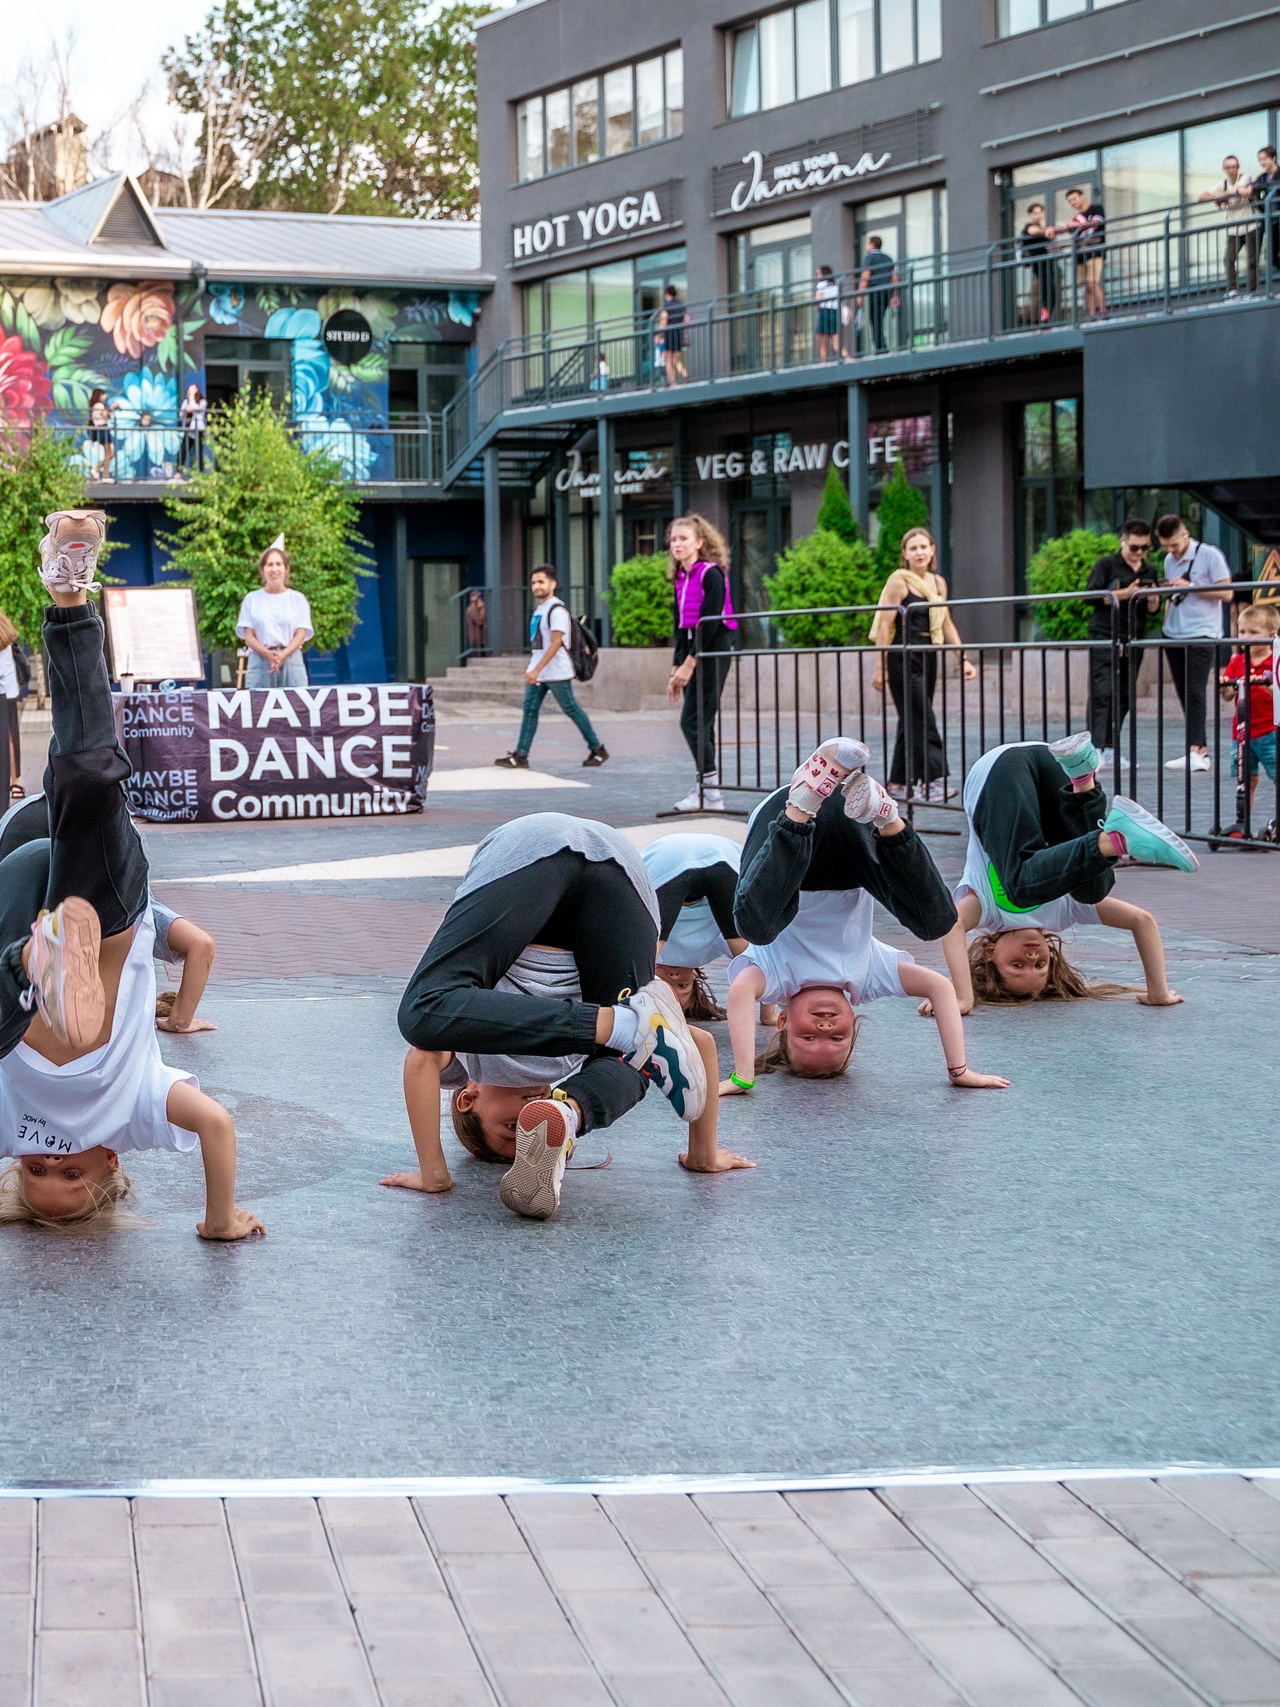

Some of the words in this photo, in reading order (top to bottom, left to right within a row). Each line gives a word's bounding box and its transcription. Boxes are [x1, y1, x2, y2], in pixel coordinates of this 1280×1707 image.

[773, 161, 802, 180] HOT
[802, 151, 839, 172] YOGA
[514, 215, 570, 258] HOT
[577, 191, 662, 240] YOGA
[695, 452, 745, 480] VEG
[750, 449, 767, 476] &
[773, 441, 829, 474] RAW
[832, 435, 901, 468] CFE
[122, 706, 195, 724] DANCE
[207, 686, 413, 729] MAYBE
[123, 724, 195, 738] Community
[209, 735, 413, 781] DANCE
[128, 769, 198, 788] MAYBE
[129, 789, 198, 806] DANCE
[211, 785, 412, 820] Community
[22, 1113, 38, 1123] MDC
[38, 1118, 47, 1128] by
[17, 1125, 73, 1154] MOVE
